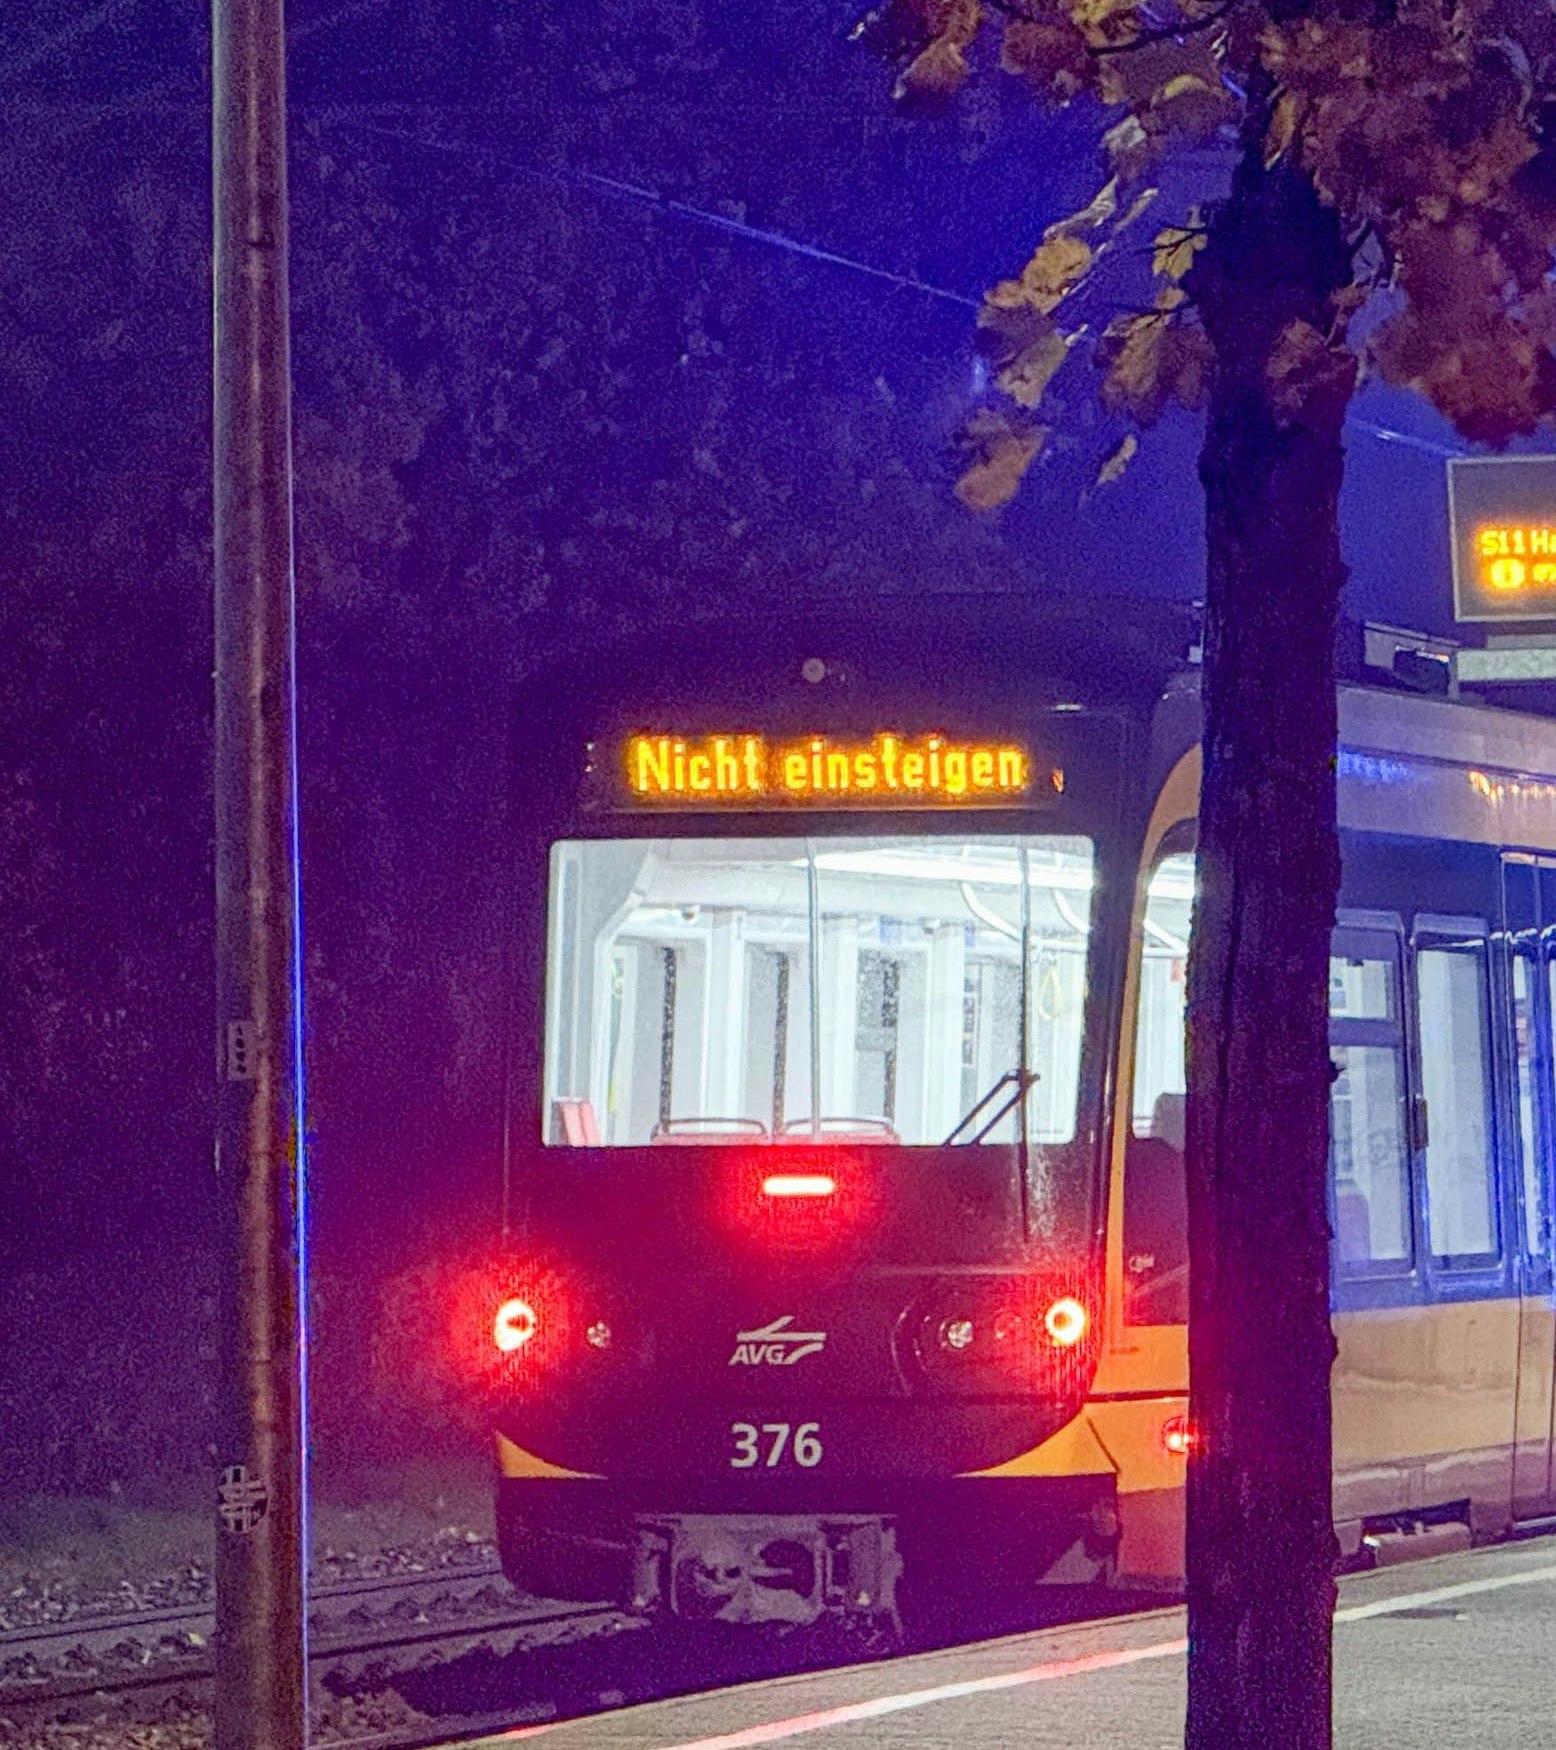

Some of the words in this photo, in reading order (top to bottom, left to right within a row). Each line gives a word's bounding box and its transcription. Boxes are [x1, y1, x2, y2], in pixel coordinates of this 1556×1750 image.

[1481, 529, 1525, 555] S11
[637, 735, 760, 791] Nicht
[785, 735, 1026, 795] einsteigen
[728, 1343, 786, 1366] AVG
[730, 1422, 823, 1468] 376
